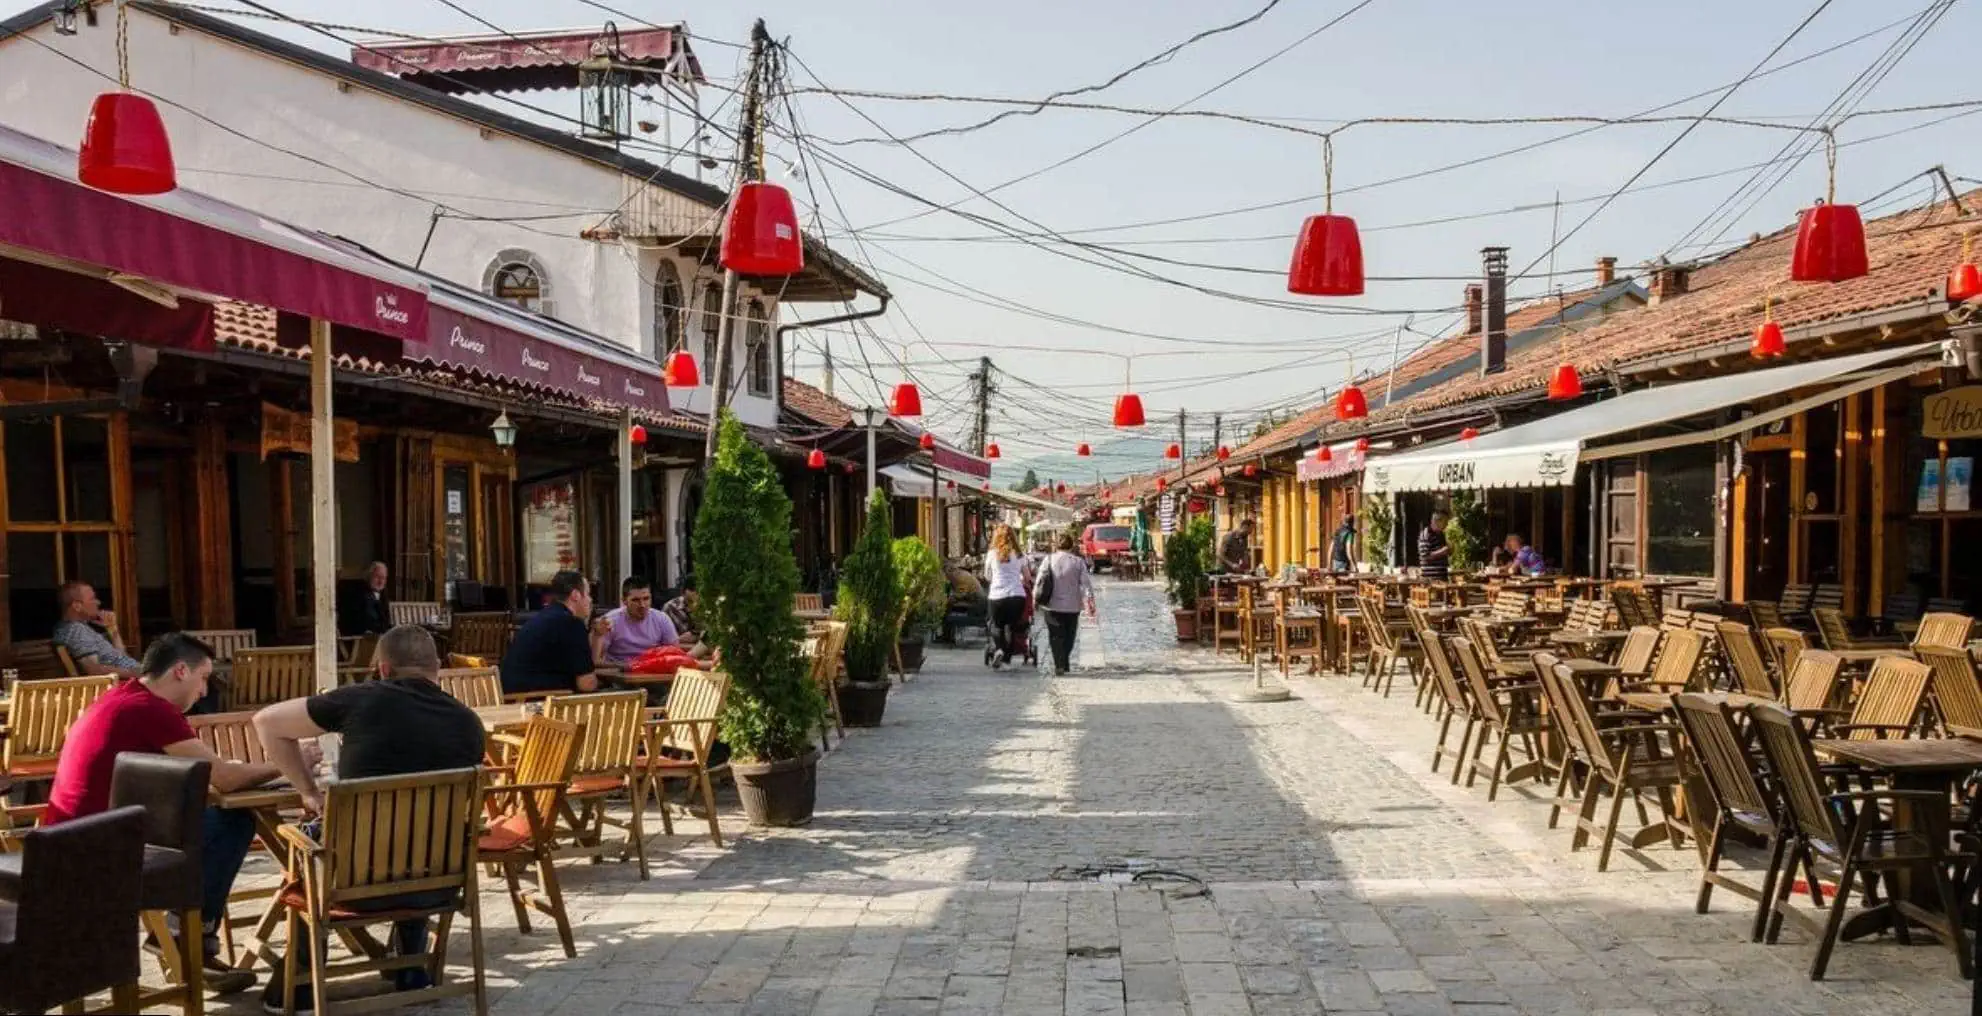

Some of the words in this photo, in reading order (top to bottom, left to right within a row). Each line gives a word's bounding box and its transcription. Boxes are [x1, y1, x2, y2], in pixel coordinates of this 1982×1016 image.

[375, 296, 409, 324] Prince
[450, 326, 485, 355] Prince
[522, 348, 550, 372] Prince
[577, 366, 600, 386] Prince
[1439, 462, 1475, 483] URBAN
